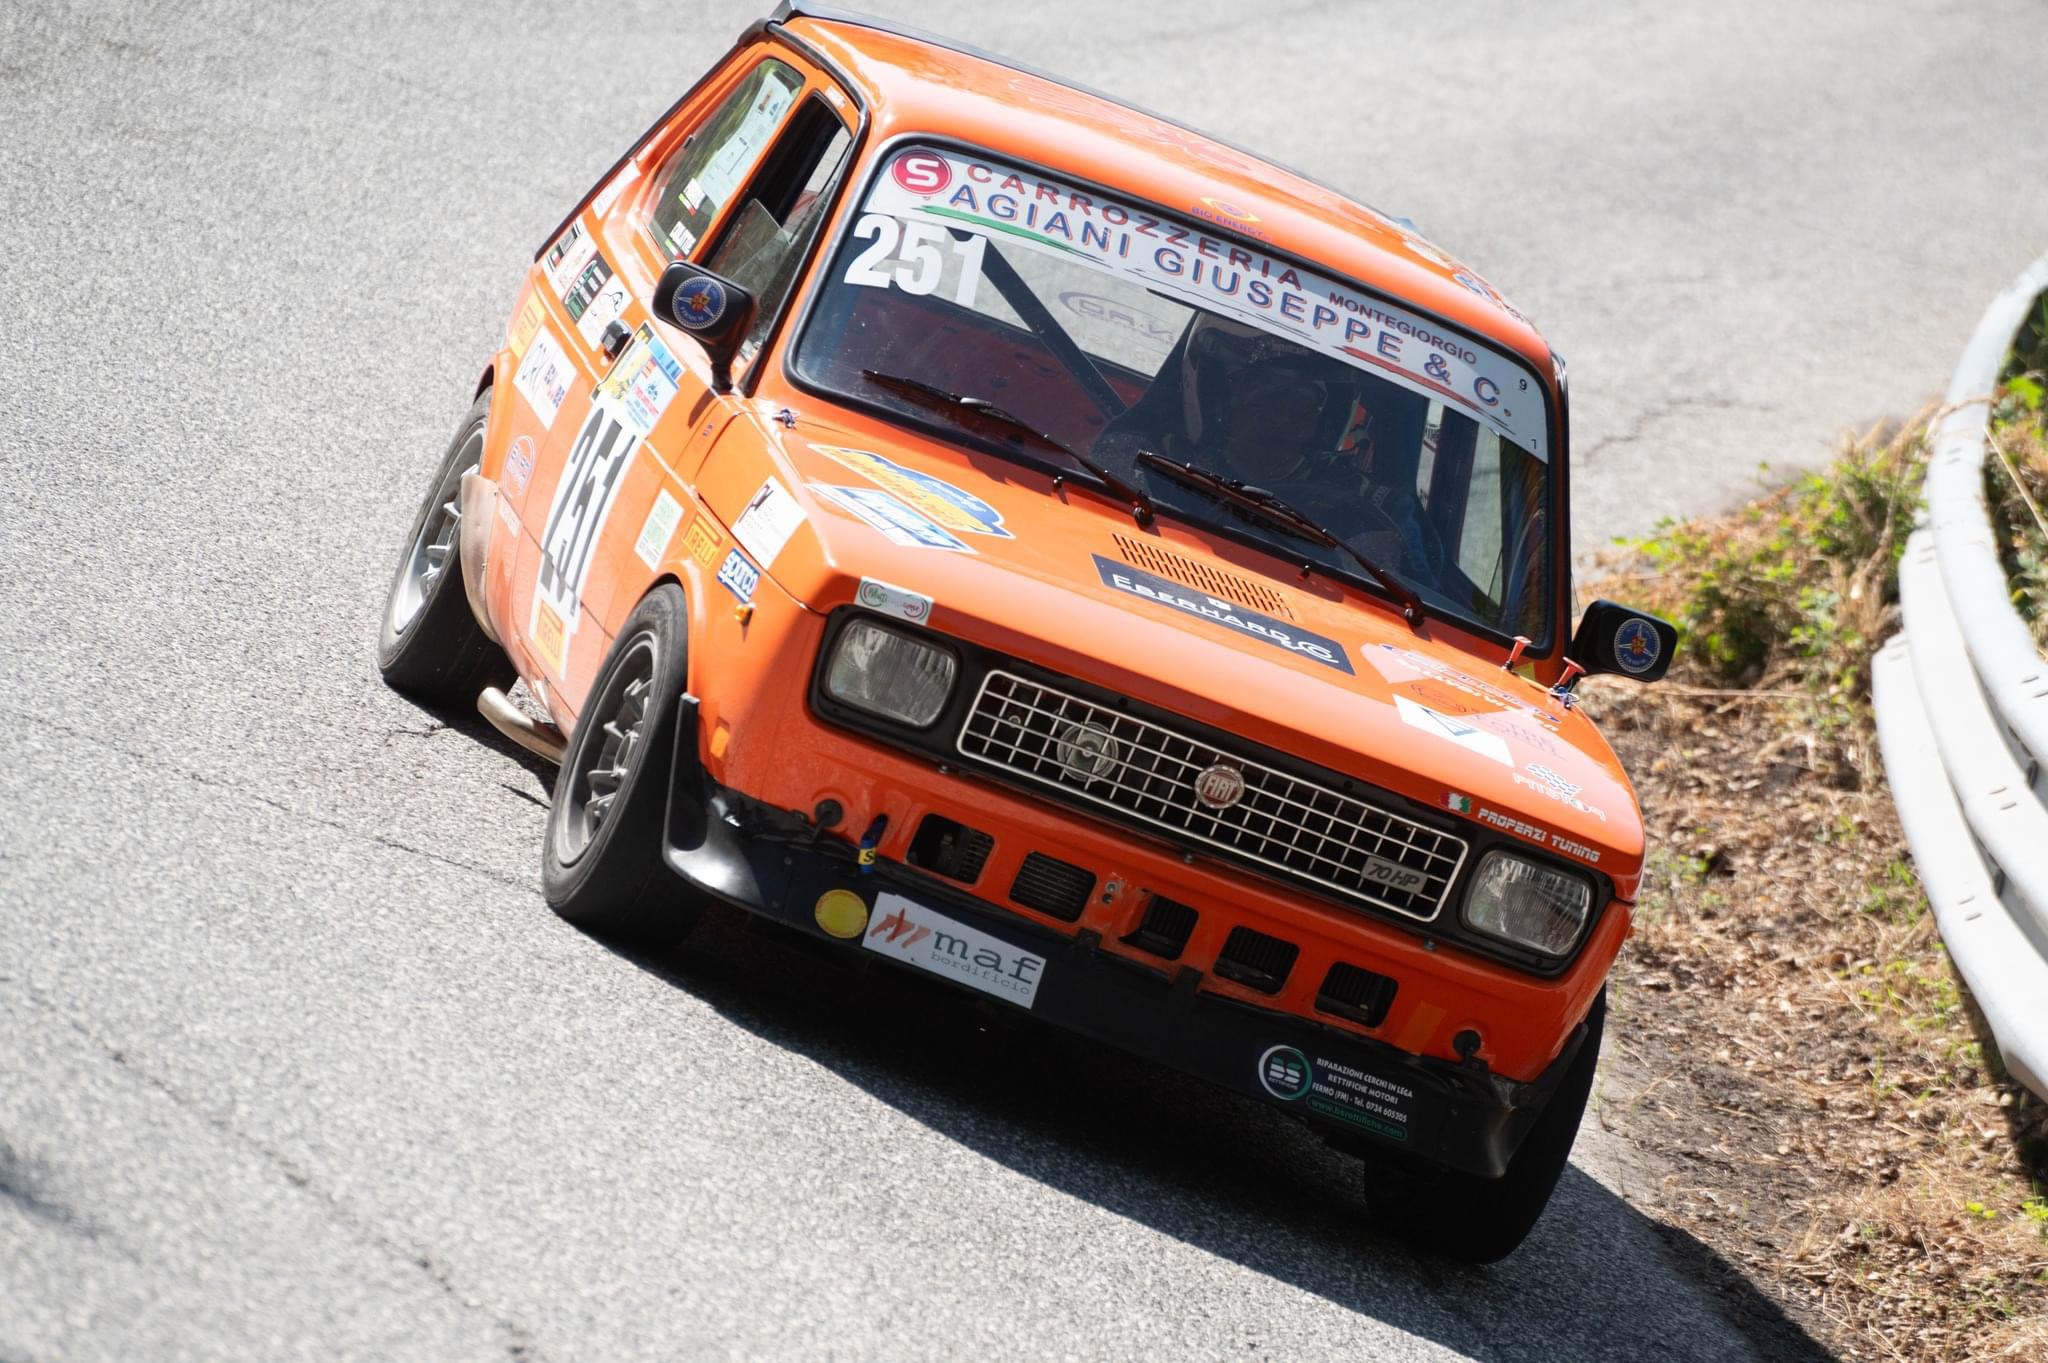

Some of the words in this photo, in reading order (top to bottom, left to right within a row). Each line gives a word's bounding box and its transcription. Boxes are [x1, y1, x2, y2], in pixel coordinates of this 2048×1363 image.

[906, 157, 940, 188] S
[967, 163, 1302, 292] CARROZZERIA
[843, 213, 987, 308] 251
[949, 184, 1131, 258] AGIANI
[1154, 247, 1404, 363] GIUSEPPE
[1424, 353, 1453, 386] &
[1472, 376, 1512, 418] C.
[1329, 291, 1478, 365] MONTEGIORGIO
[540, 407, 636, 616] 251
[1112, 574, 1291, 641] EBERHARD
[1202, 774, 1238, 799] FIAT
[1367, 862, 1394, 881] 70
[1391, 870, 1421, 888] HP
[931, 951, 1030, 996] bordificio
[934, 930, 1041, 985] maf
[1311, 1082, 1334, 1096] FERMO
[1335, 1091, 1349, 1104] (FM)
[1316, 1057, 1364, 1081] RIPARAZIONE
[1364, 1073, 1388, 1088] CERCHI
[1387, 1082, 1397, 1092] IN
[1396, 1085, 1413, 1098] LEGA
[1328, 1074, 1368, 1093] RETTIFICHE
[1368, 1088, 1399, 1105] MOTORI
